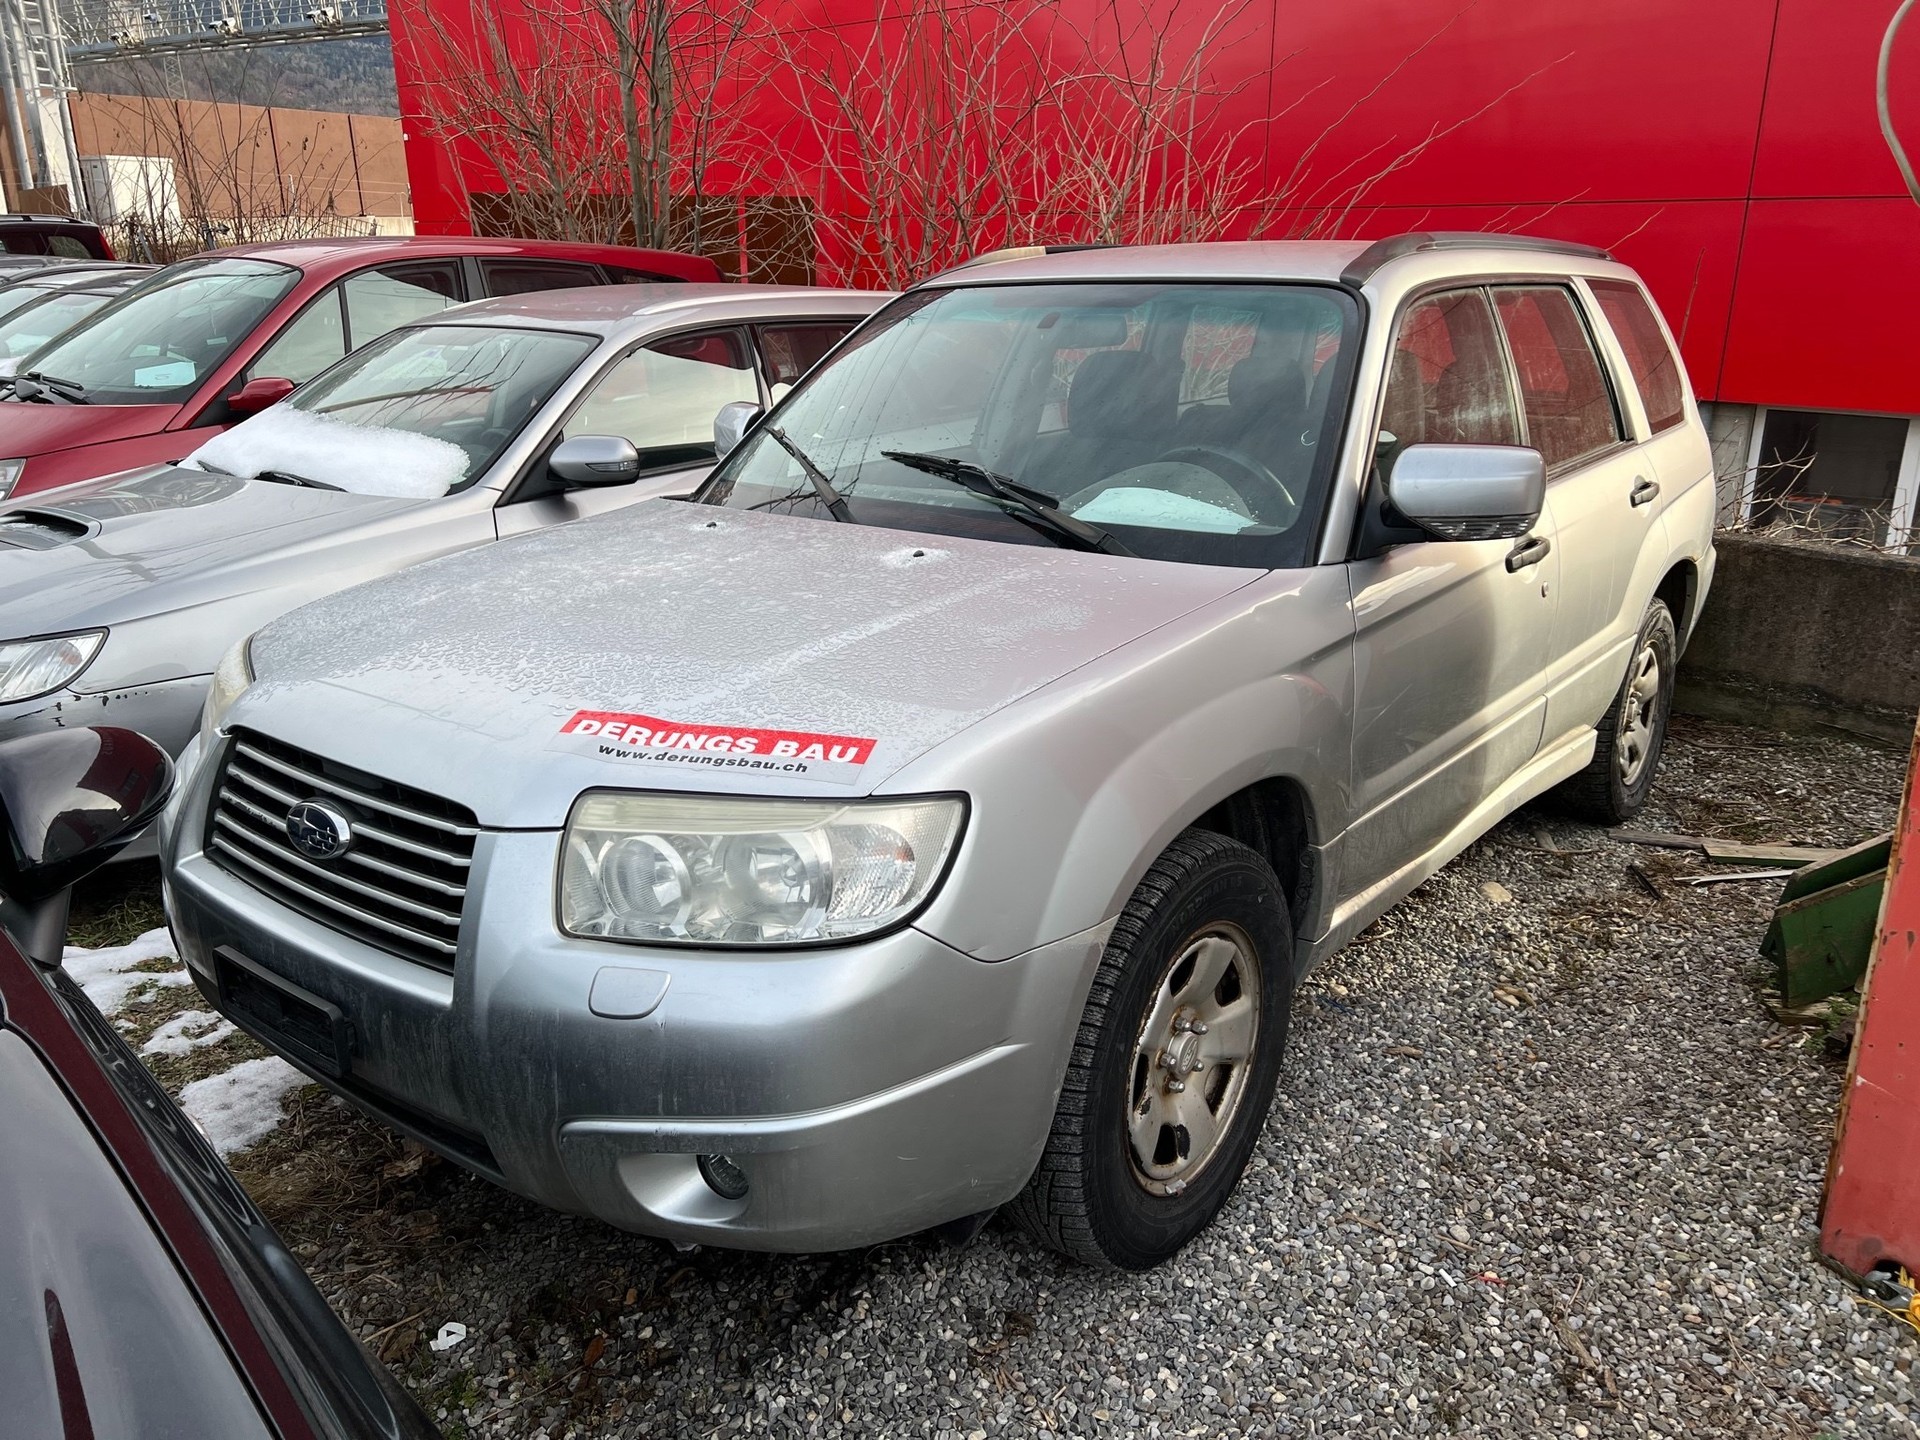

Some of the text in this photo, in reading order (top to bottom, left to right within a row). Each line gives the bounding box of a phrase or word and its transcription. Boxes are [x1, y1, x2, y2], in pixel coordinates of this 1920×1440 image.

[571, 719, 859, 763] DERUNGS BAU
[598, 744, 808, 773] www.derungsbau.ch
